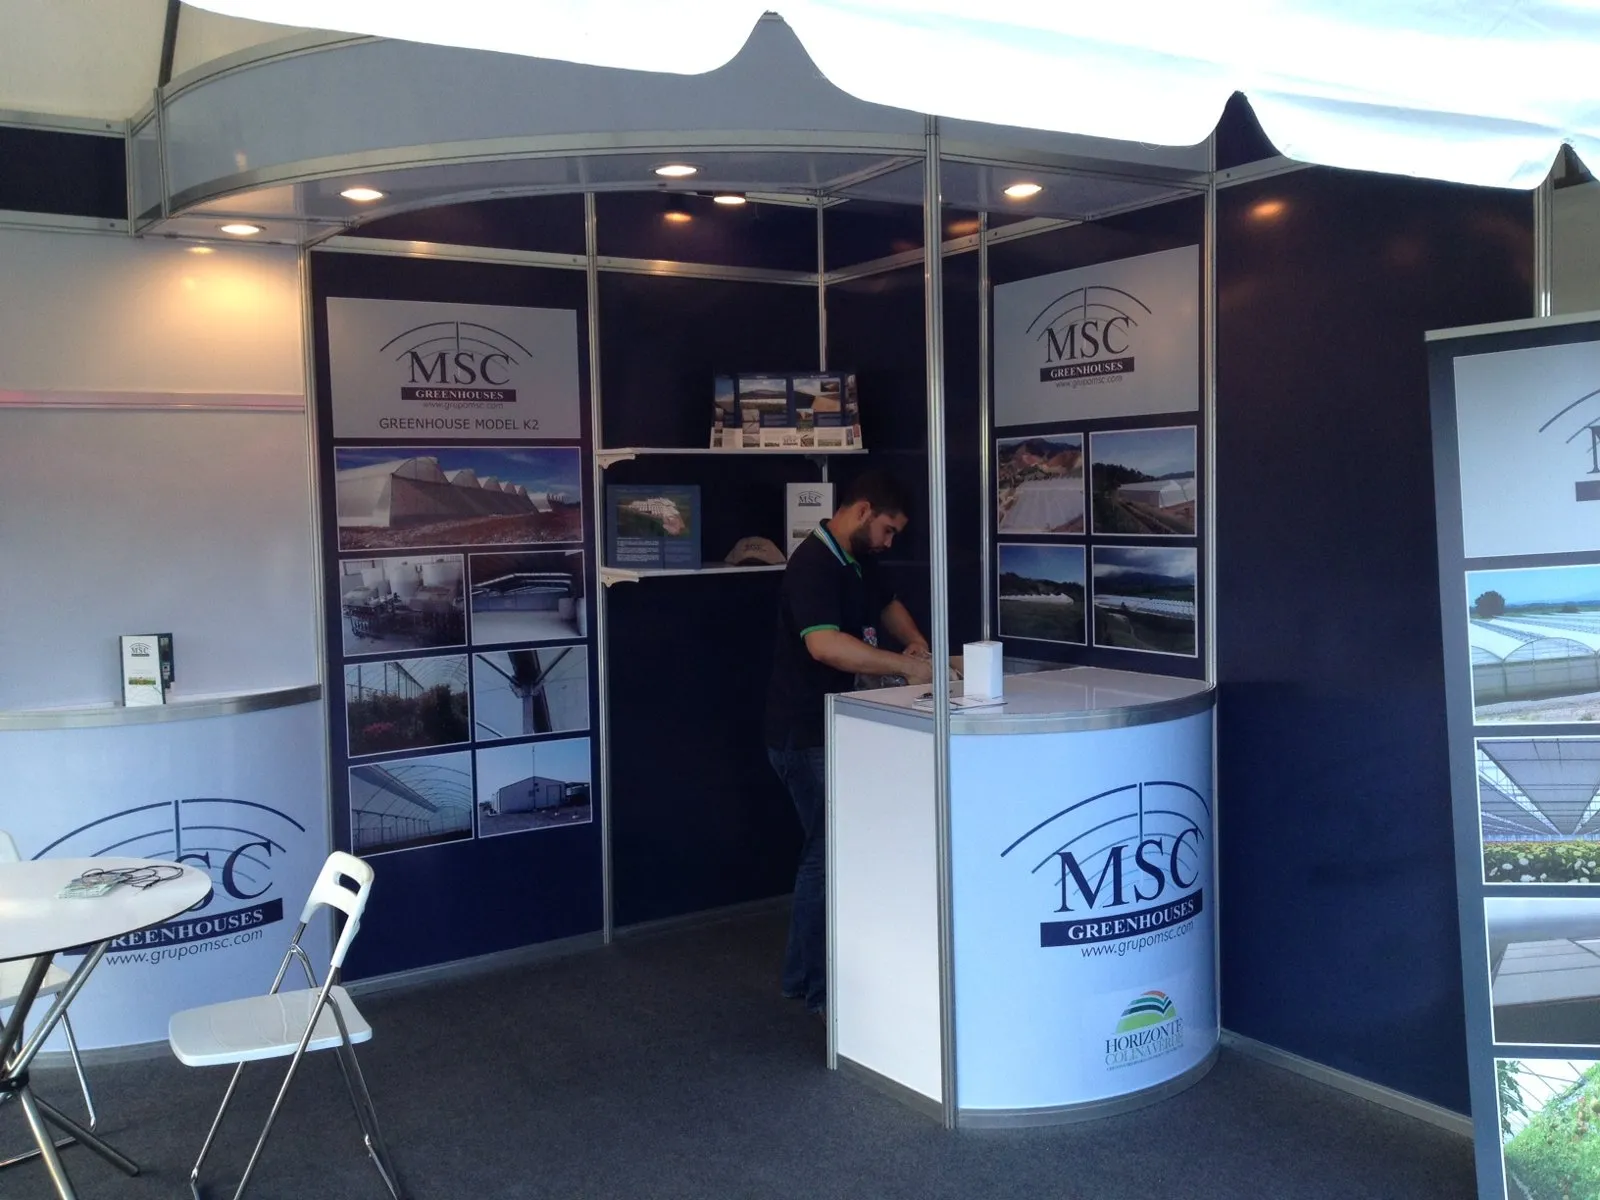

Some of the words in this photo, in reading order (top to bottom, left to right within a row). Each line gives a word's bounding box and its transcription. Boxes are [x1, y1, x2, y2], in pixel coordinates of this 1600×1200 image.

[1045, 316, 1130, 363] MSC
[409, 351, 511, 385] MSC
[1050, 362, 1124, 378] GREENHOUSES
[1055, 375, 1123, 389] www.grupomsc.com
[415, 389, 504, 400] GREENHOUSES
[422, 401, 504, 410] www.grupomsc.com
[379, 418, 470, 430] GREENHOUSE
[475, 419, 518, 430] MODEL
[523, 419, 540, 431] K2
[1054, 827, 1200, 913] MSC
[111, 908, 264, 948] REENHOUSES
[1068, 899, 1194, 940] GREENHOUSES
[106, 929, 264, 965] www.grupomsc.com
[1081, 920, 1194, 958] www.grupomsc.com
[1105, 1017, 1183, 1053] HORIZONTE
